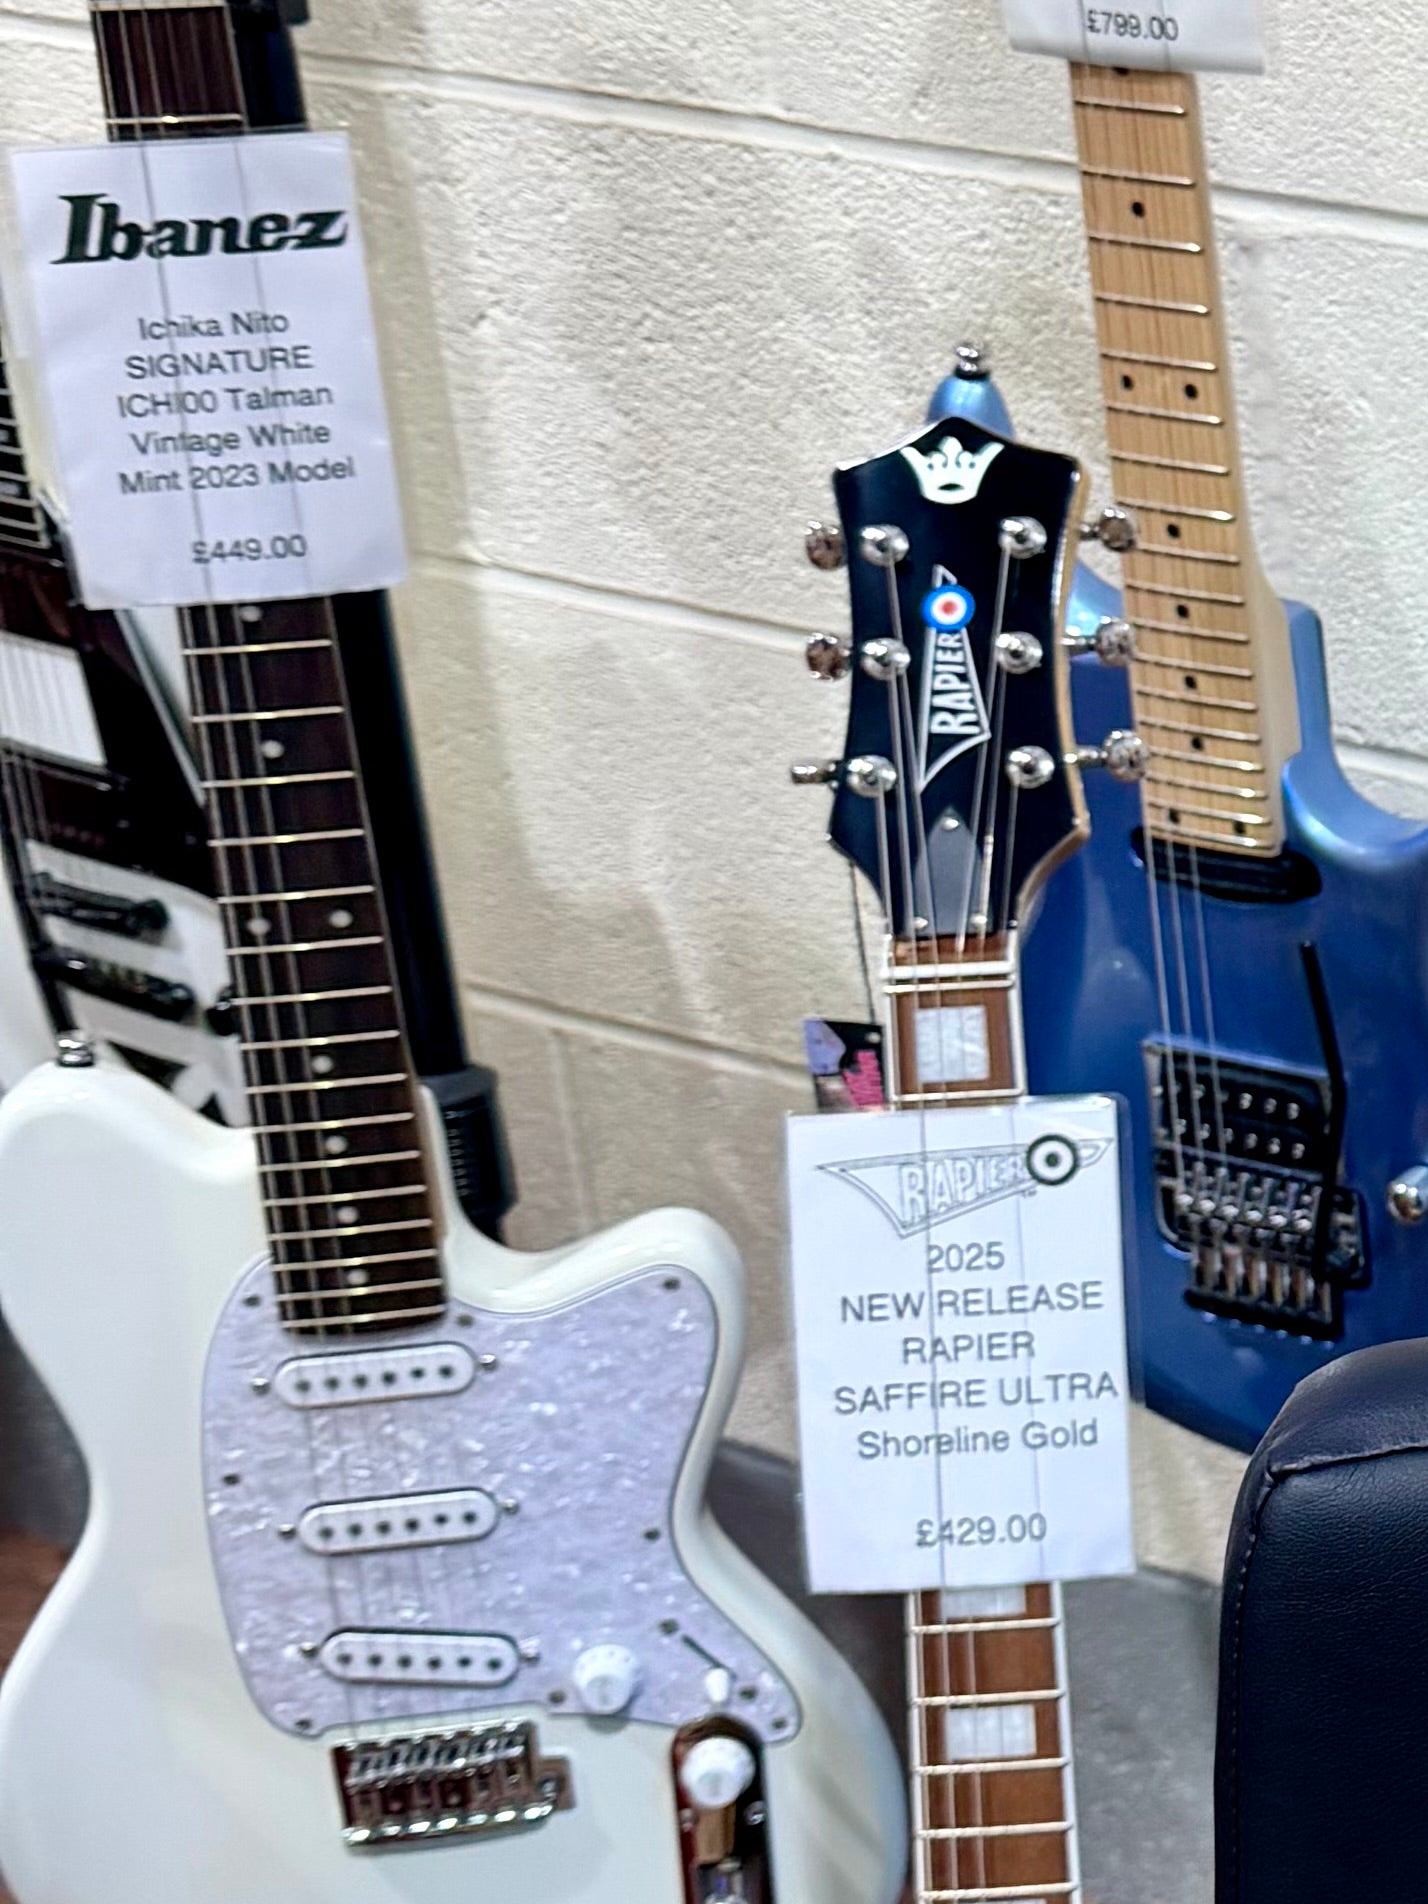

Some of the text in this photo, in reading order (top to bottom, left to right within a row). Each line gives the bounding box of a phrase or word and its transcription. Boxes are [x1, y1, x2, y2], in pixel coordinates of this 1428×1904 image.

[1087, 11, 1179, 42] £799.00
[50, 193, 349, 265] Ibanez
[139, 310, 290, 340] Ichika Nito
[125, 345, 314, 380] SIGNATURE
[224, 385, 334, 412] Talman
[130, 423, 331, 458] Vintage White
[119, 456, 355, 495] Mint 2023 Model
[192, 535, 307, 566] £449.00
[929, 631, 982, 735] RAPIER
[898, 1152, 1029, 1228] RAPIER
[928, 1241, 1005, 1274] 2025
[841, 1281, 1104, 1323] NEW RELEASE
[902, 1331, 1036, 1365] RAPIER
[835, 1371, 1119, 1415] SAFFIRE ULTRA
[857, 1418, 1099, 1460] Shoreline Gold
[916, 1513, 1048, 1549] £429.00
